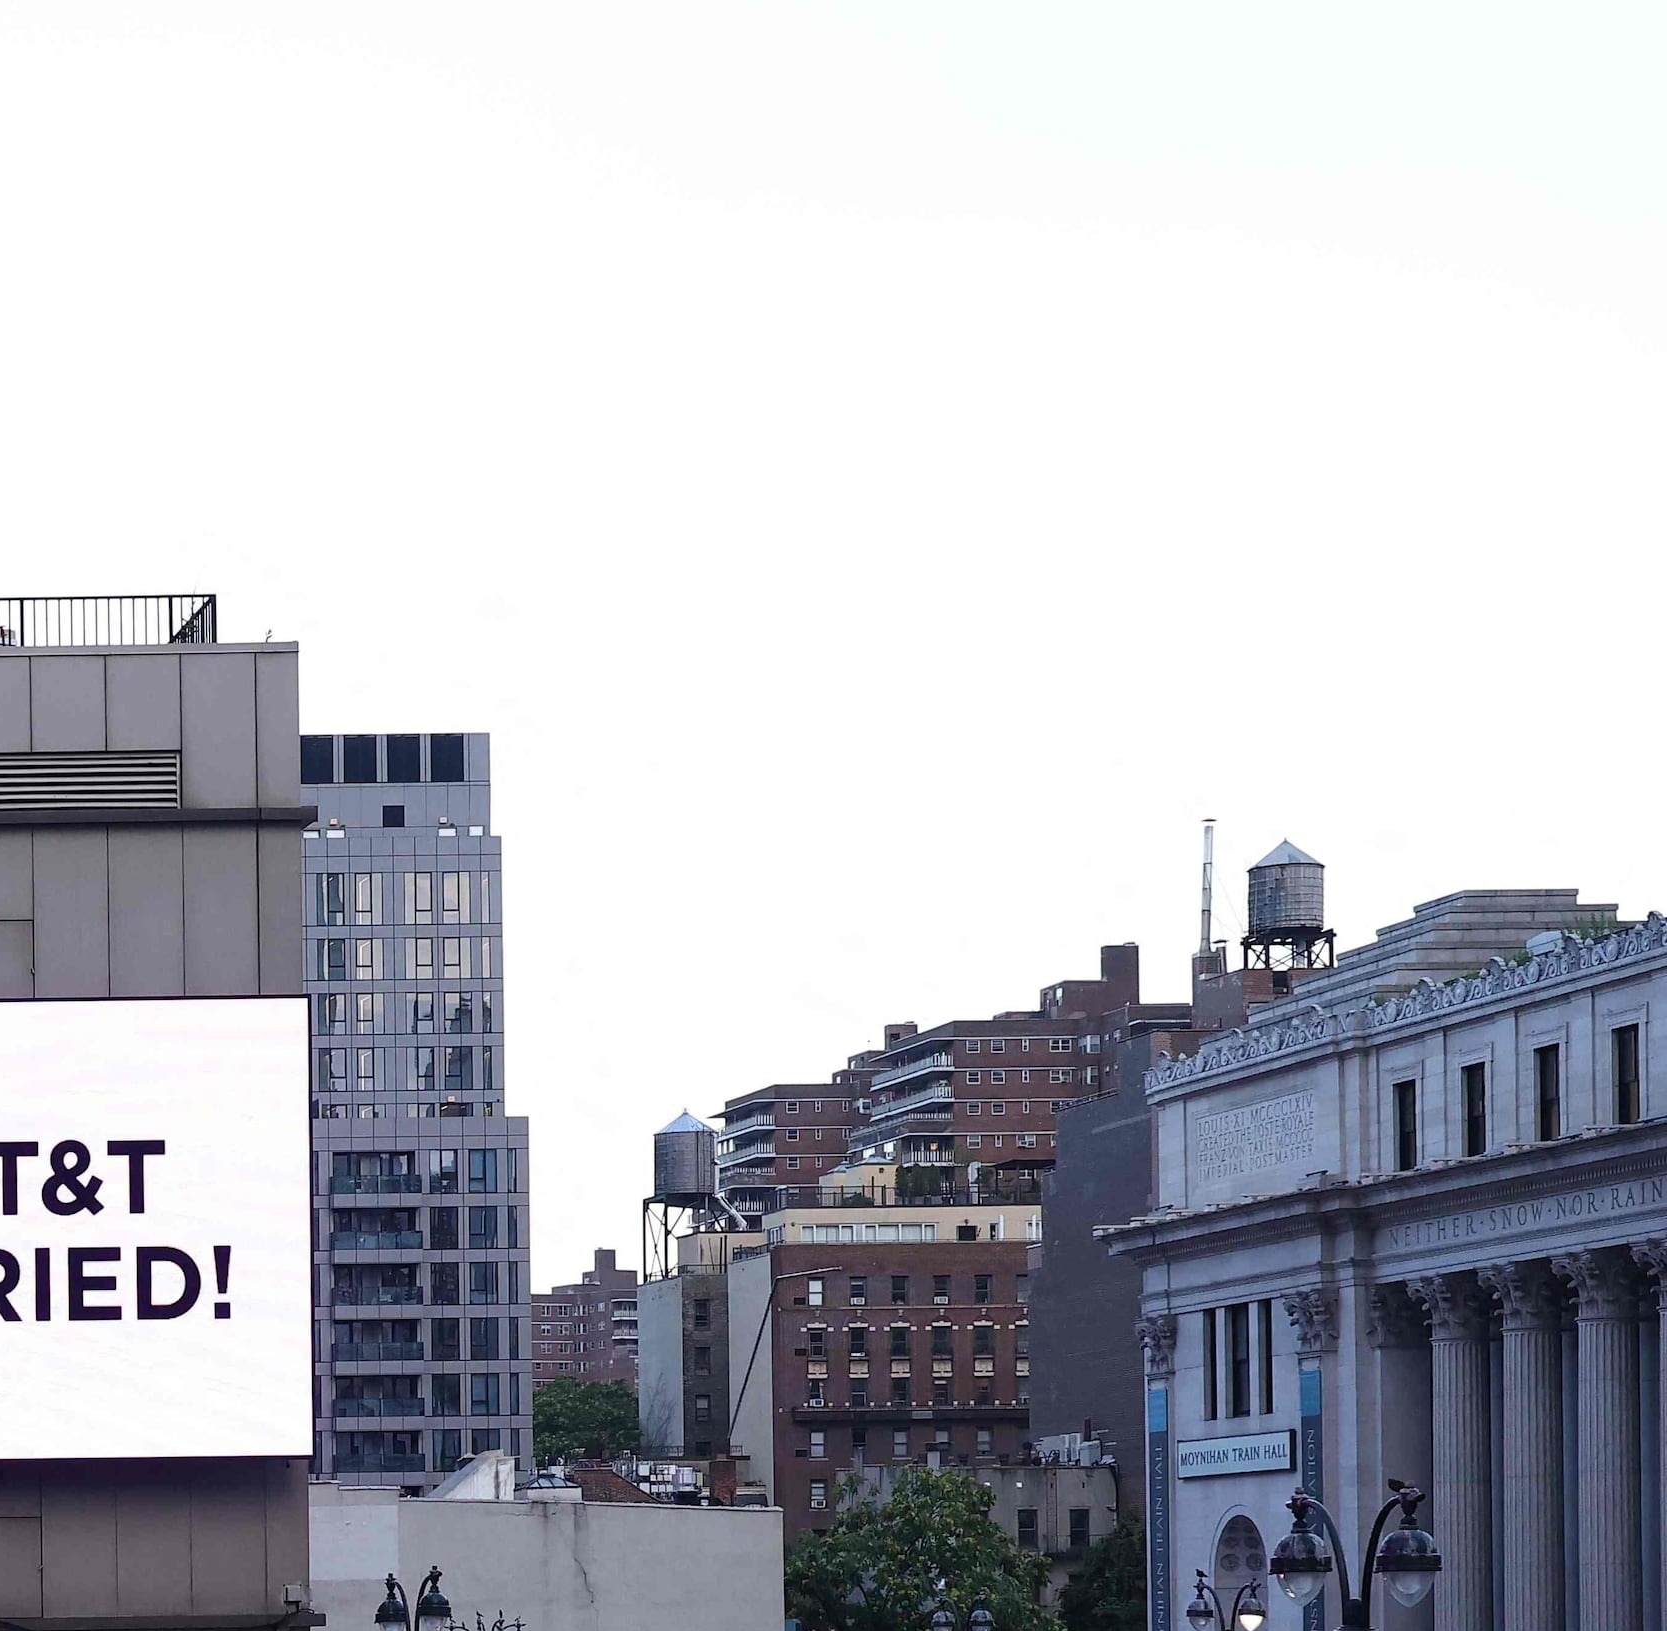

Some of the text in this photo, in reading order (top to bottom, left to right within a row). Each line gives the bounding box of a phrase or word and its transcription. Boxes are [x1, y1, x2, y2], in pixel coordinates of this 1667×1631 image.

[1198, 1115, 1229, 1137] LOUIS
[1233, 1112, 1246, 1129] XI
[1235, 1126, 1251, 1142] THE
[1388, 1178, 1664, 1249] NEITHER SNOW NOR RAIN
[1180, 1443, 1288, 1466] MOYNIHAN TRAIN HALL
